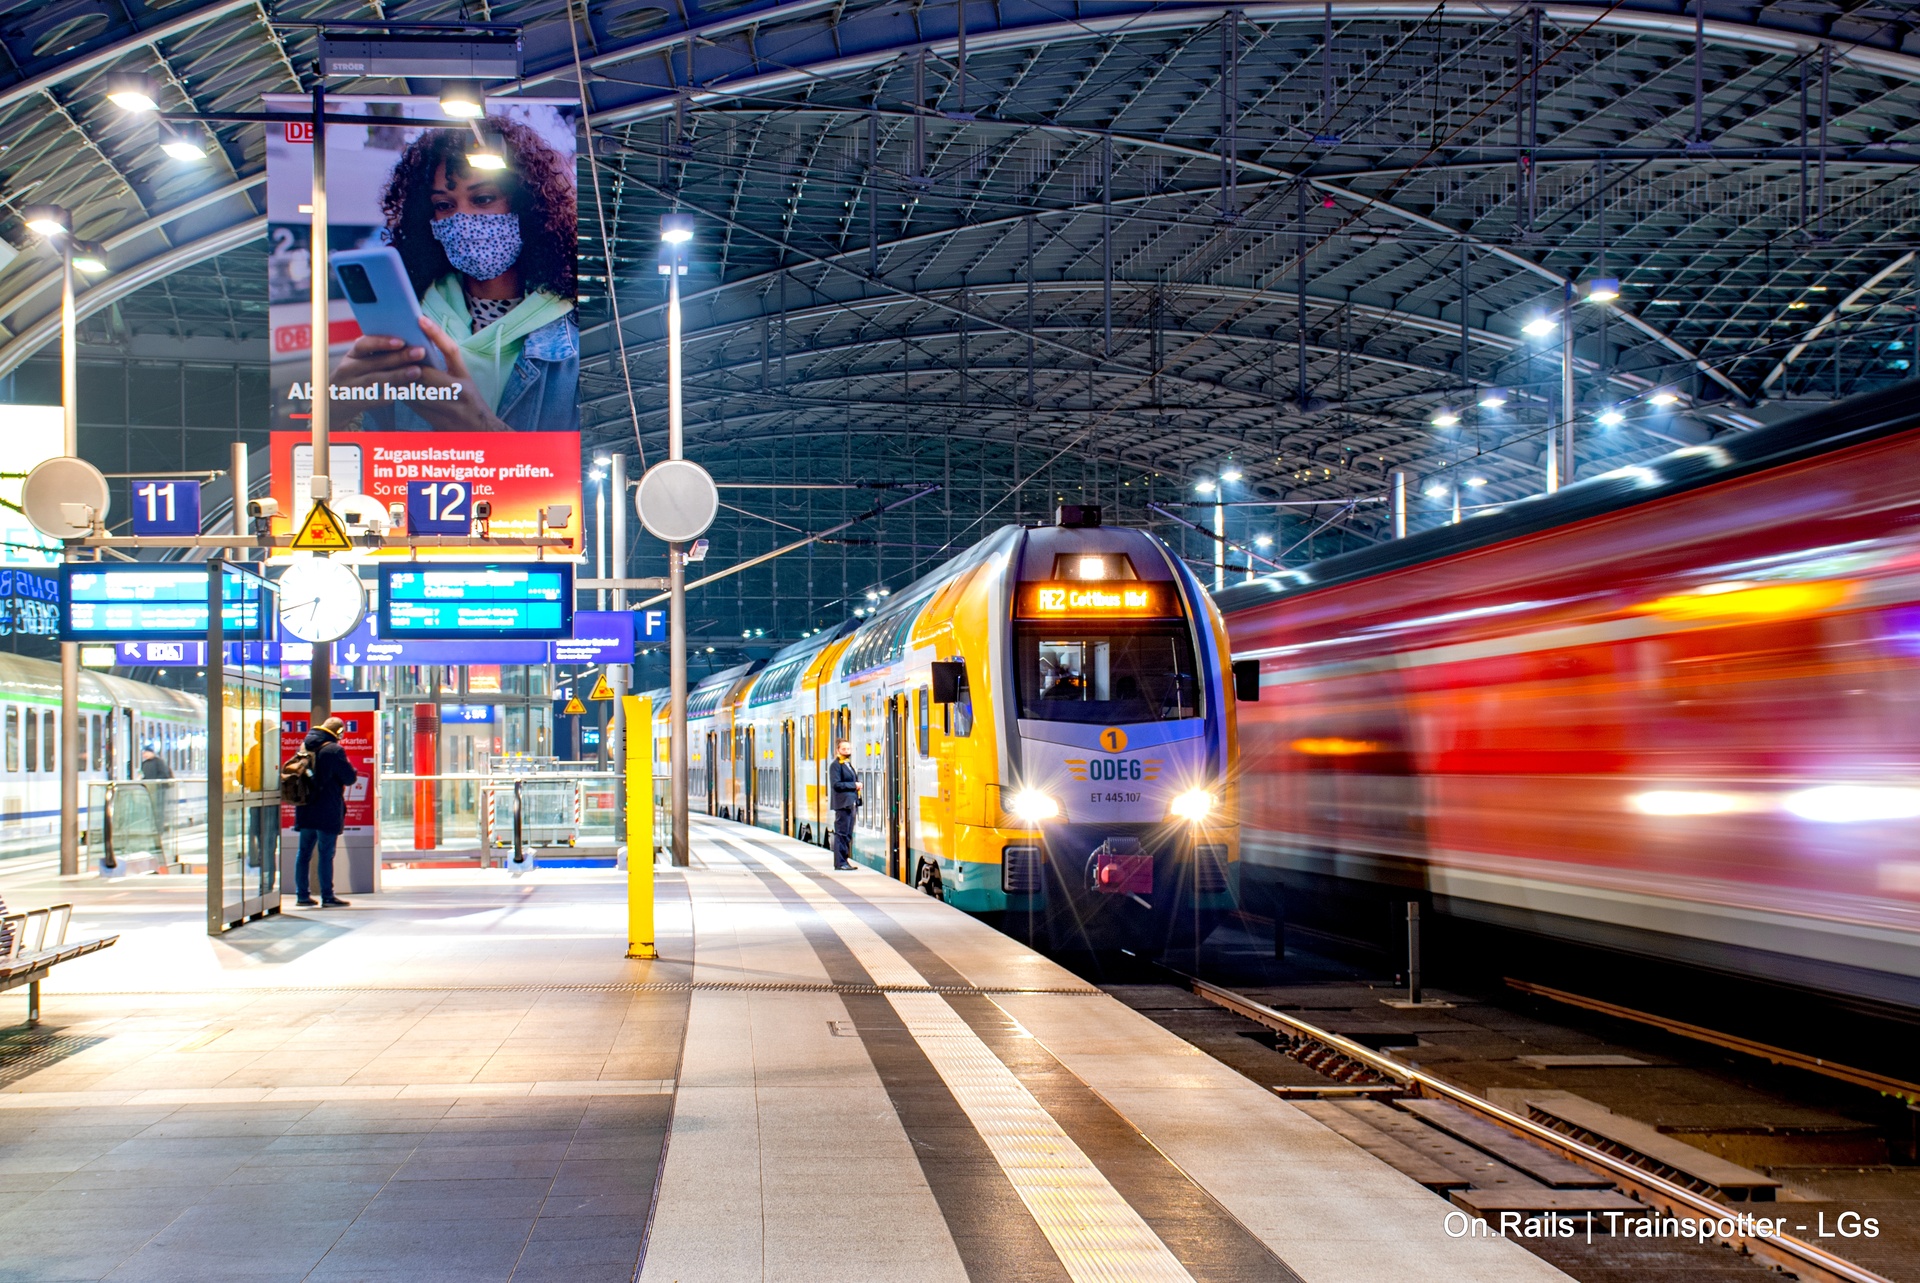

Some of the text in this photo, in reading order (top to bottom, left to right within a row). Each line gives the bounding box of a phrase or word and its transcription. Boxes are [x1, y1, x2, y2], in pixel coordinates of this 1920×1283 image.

[332, 61, 366, 72] STRÖER
[288, 122, 313, 140] DB
[288, 382, 463, 400] Abtand halten?
[373, 447, 485, 463] Zugauslastung
[373, 464, 554, 480] im DB Navigator prüfen.
[373, 482, 390, 495] So
[472, 484, 495, 495] ute.
[138, 484, 176, 521] 11
[421, 483, 466, 521] 12
[1070, 591, 1121, 606] Cottbus
[646, 612, 661, 635] F
[1107, 731, 1117, 749] 1
[1090, 759, 1141, 780] ODEG
[1091, 792, 1141, 803] ET 445.107
